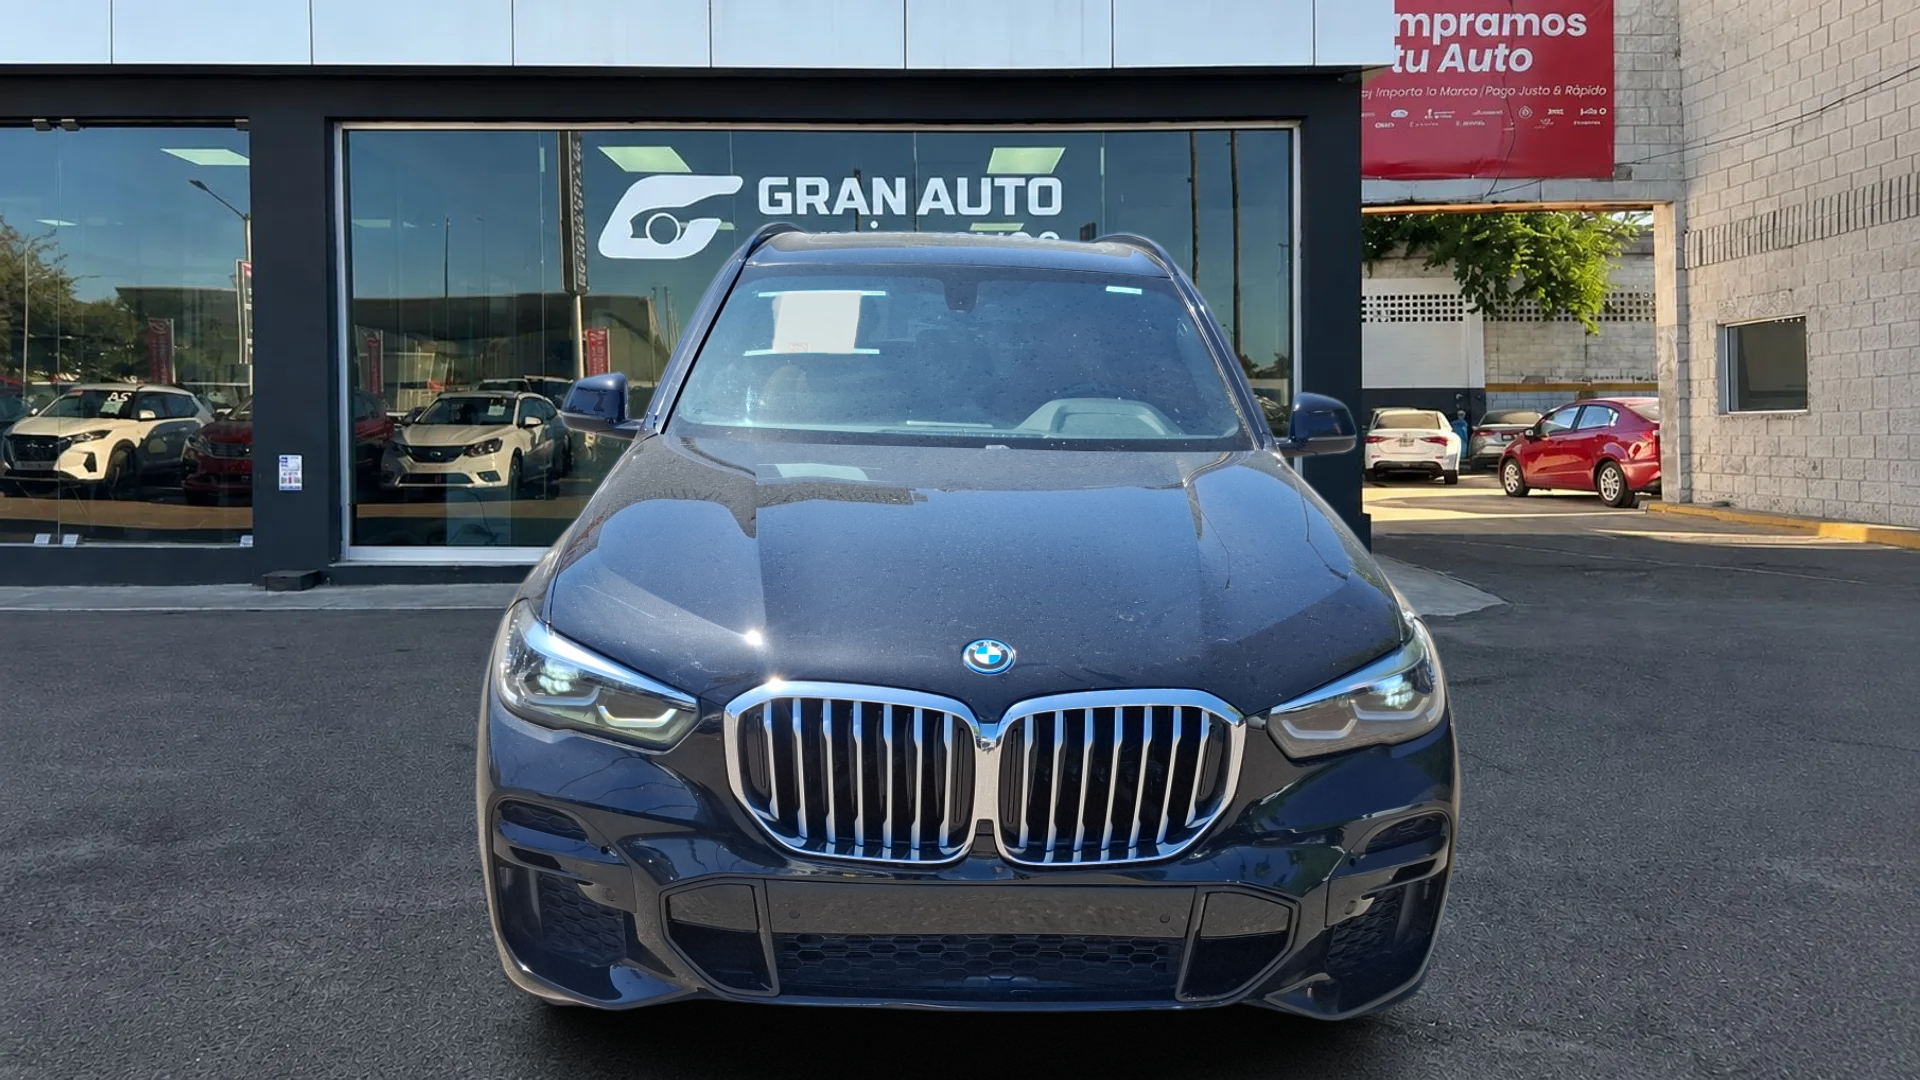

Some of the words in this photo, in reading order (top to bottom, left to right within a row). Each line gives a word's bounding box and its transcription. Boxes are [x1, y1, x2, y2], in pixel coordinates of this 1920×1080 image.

[1392, 44, 1430, 73] tu
[1437, 43, 1533, 73] Auto
[1376, 86, 1423, 99] Importa
[1440, 86, 1478, 96] Marca
[1519, 86, 1551, 96] Justo
[1553, 86, 1562, 95] &
[758, 176, 907, 216] GRAN
[917, 176, 1063, 216] AUTO
